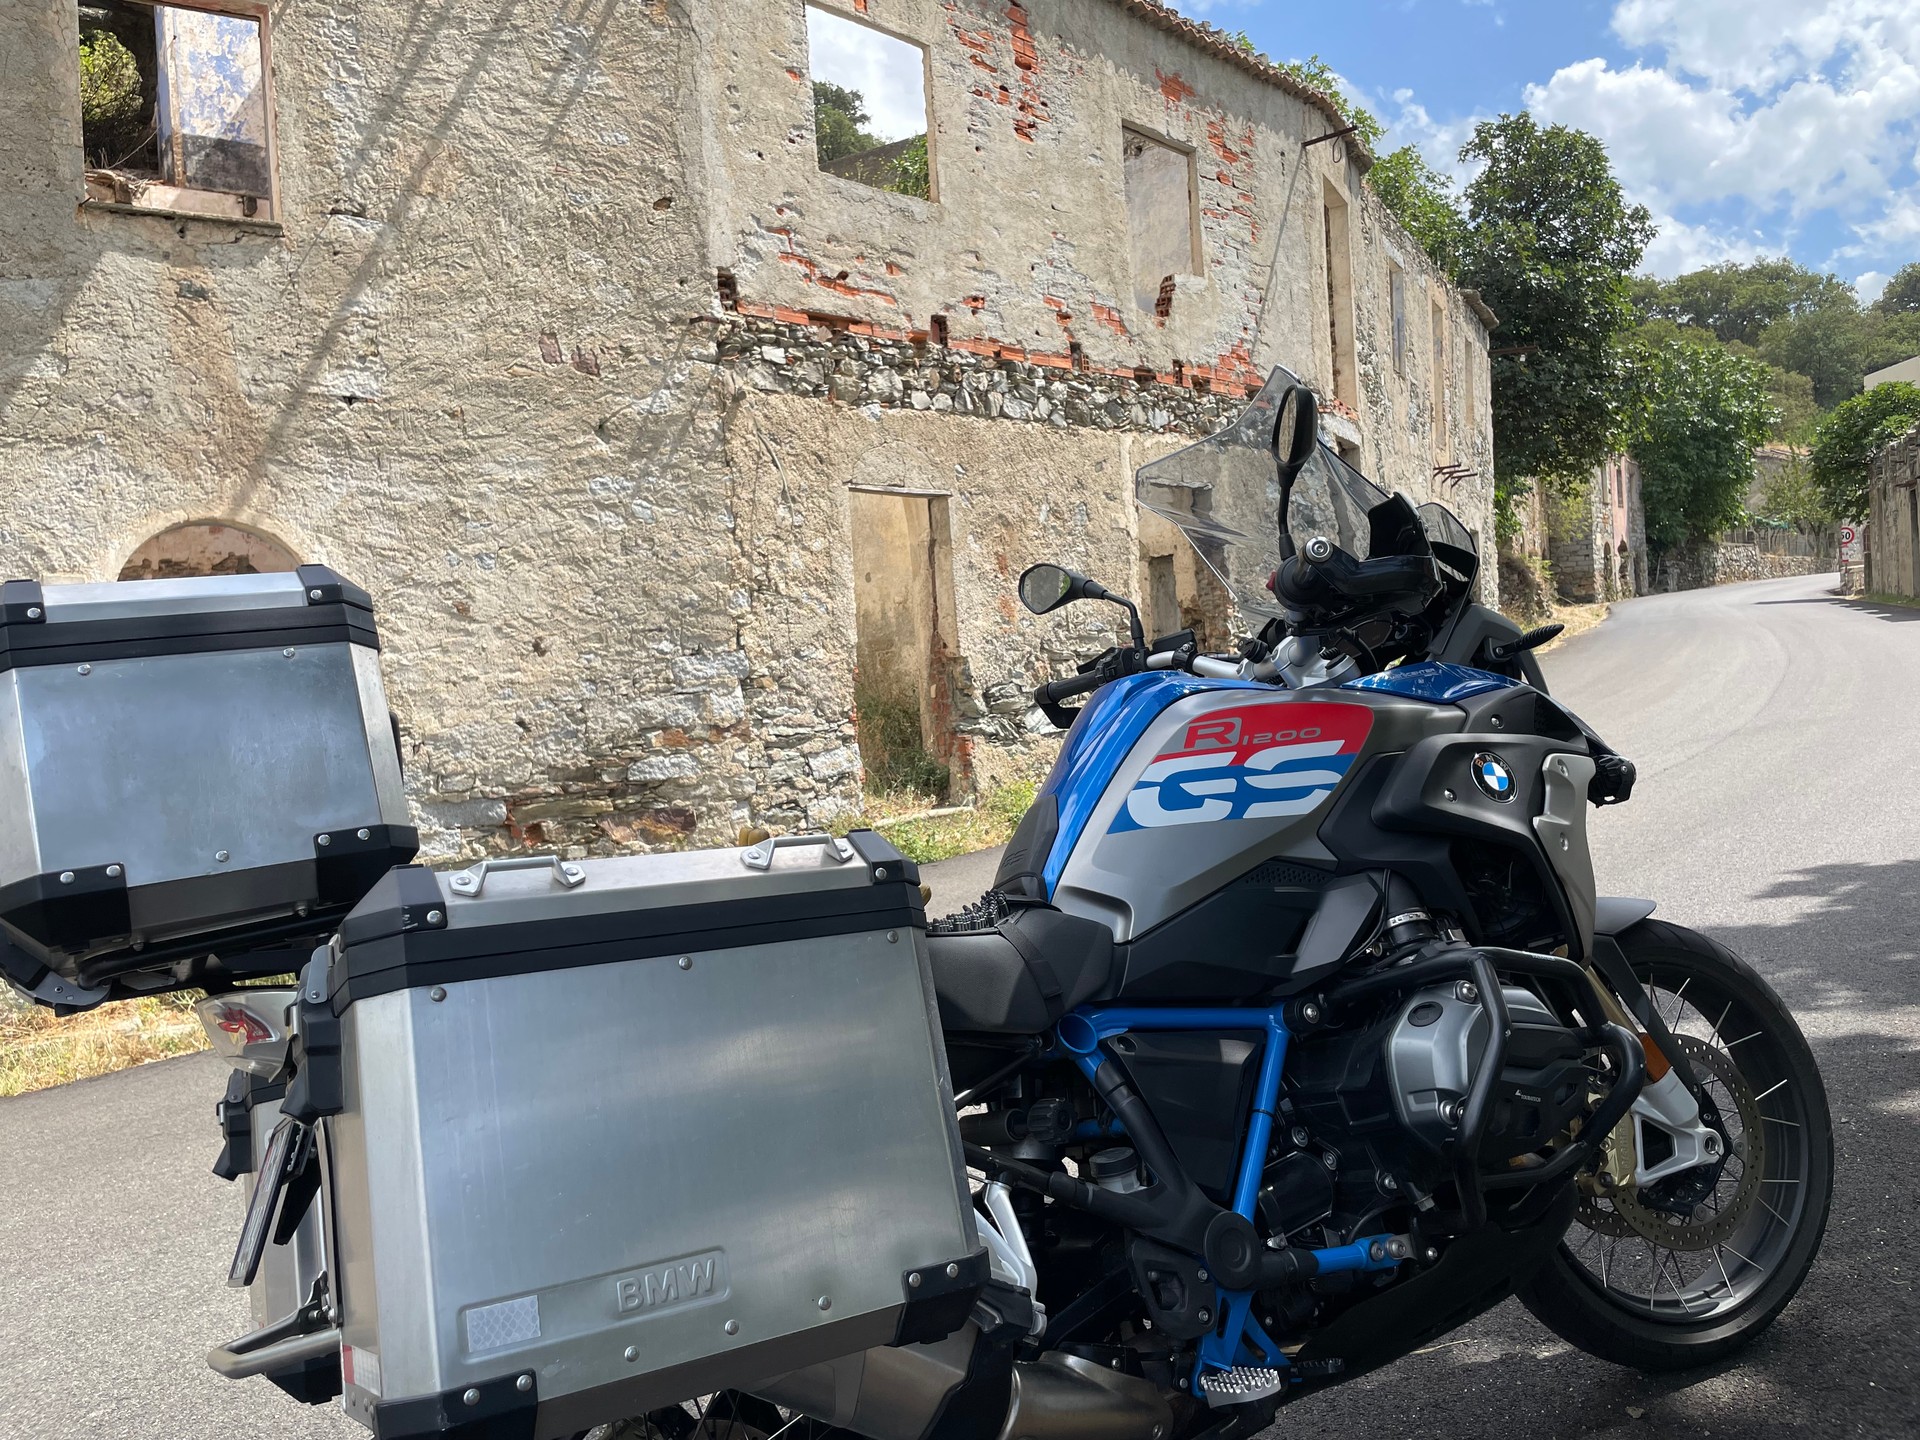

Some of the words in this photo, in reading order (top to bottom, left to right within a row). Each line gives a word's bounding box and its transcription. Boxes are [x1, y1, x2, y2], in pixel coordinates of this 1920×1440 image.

[1126, 740, 1346, 828] GS
[1475, 755, 1509, 770] BMW
[616, 1258, 716, 1313] BMW
